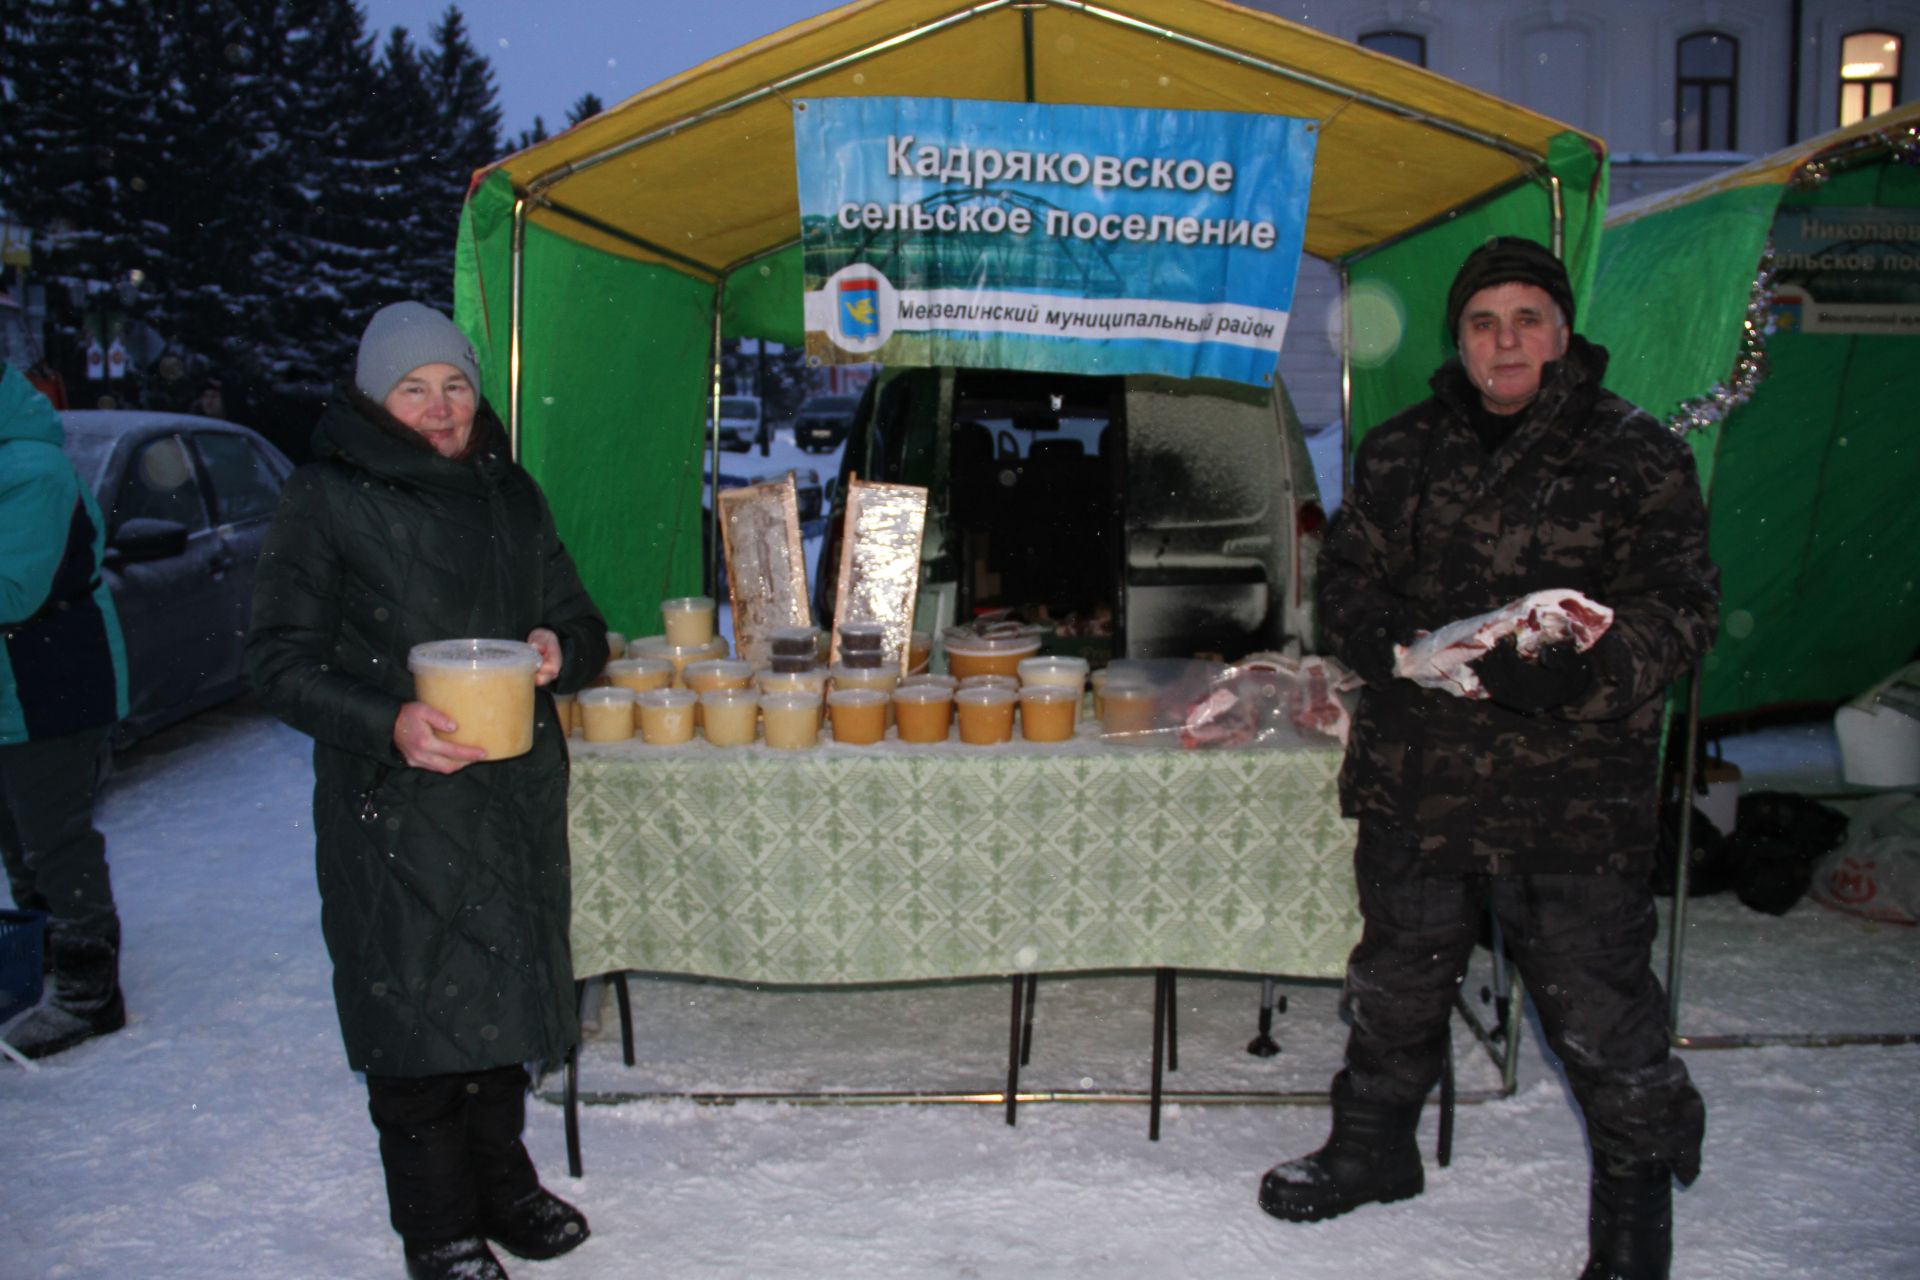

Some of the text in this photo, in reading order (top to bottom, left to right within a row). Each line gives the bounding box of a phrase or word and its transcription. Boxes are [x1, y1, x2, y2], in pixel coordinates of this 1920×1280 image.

[887, 134, 1234, 193] Кадряковское
[837, 199, 1277, 250] сельское поселение
[1773, 250, 1875, 271] ельское
[897, 299, 1275, 339] Мензелинский муниципальный район
